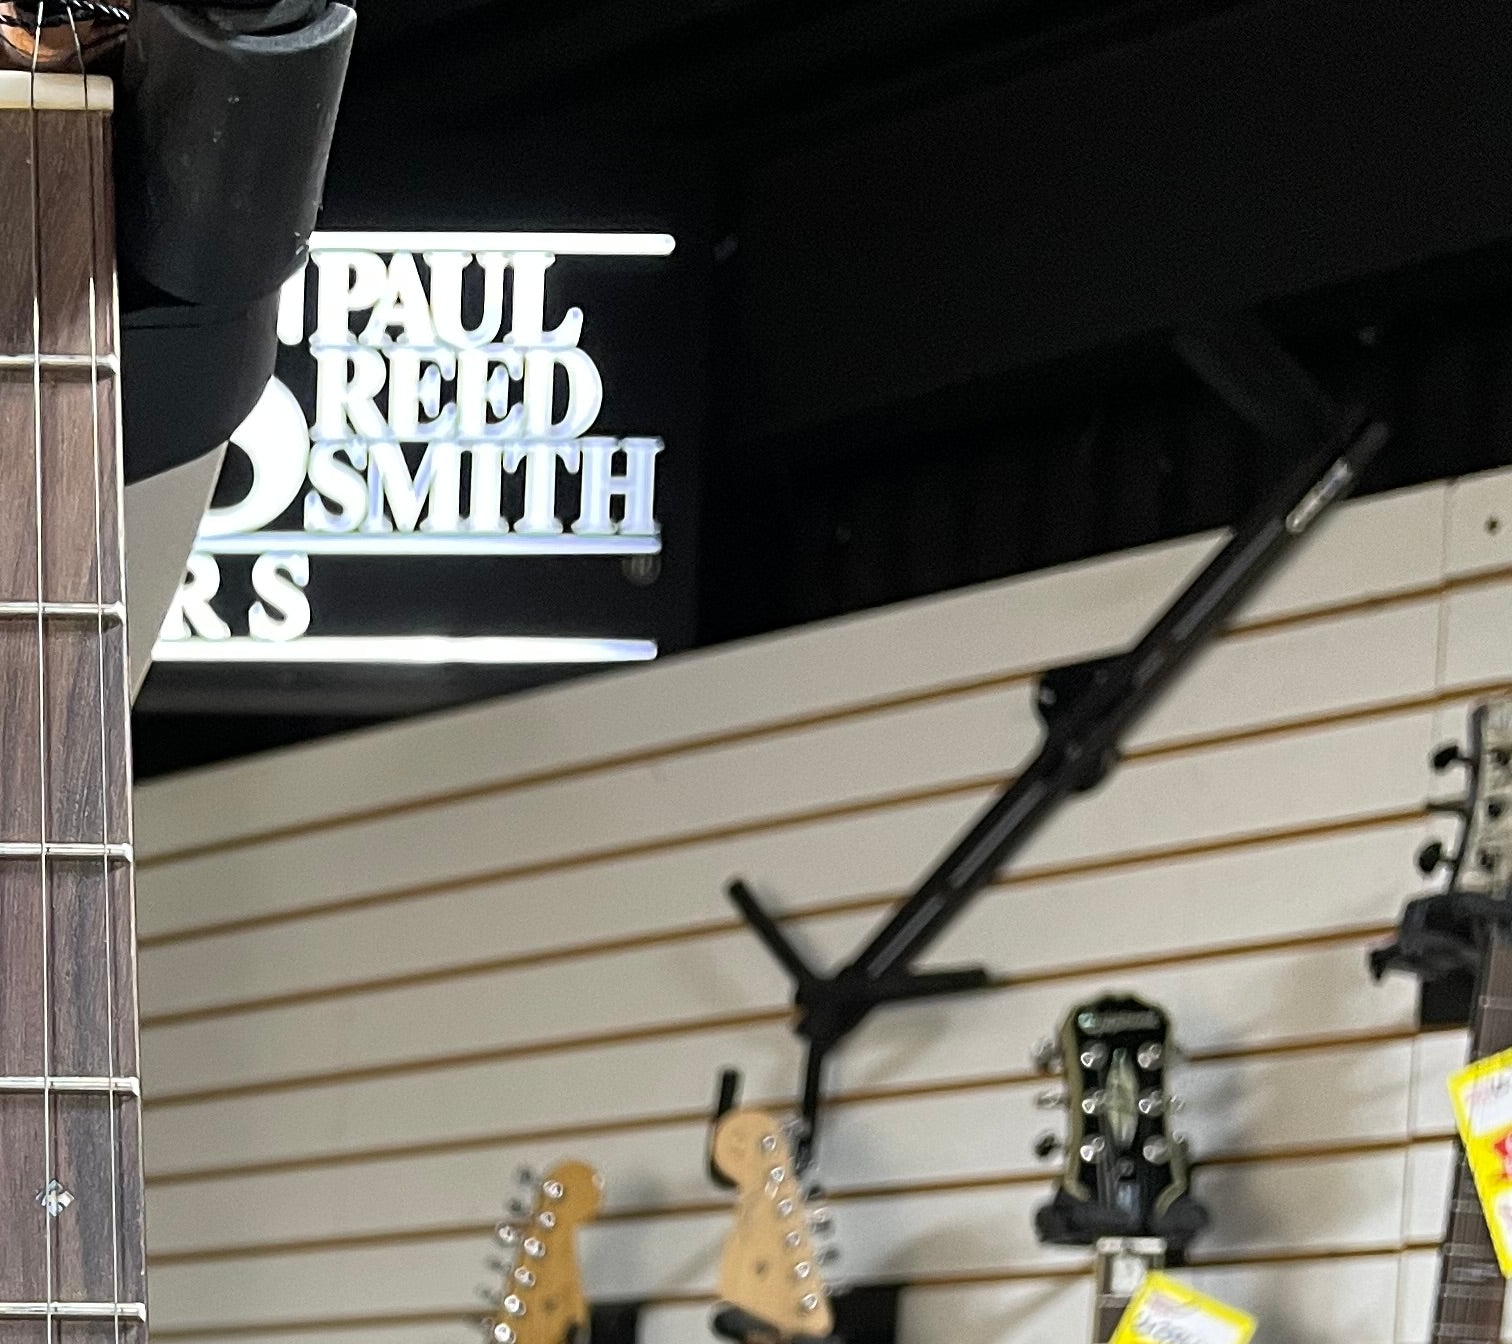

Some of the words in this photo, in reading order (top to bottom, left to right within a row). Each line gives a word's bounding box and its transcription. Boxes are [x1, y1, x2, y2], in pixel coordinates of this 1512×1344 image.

[310, 249, 583, 347] PAUL
[310, 344, 603, 442] REED
[303, 436, 665, 535] SMITH
